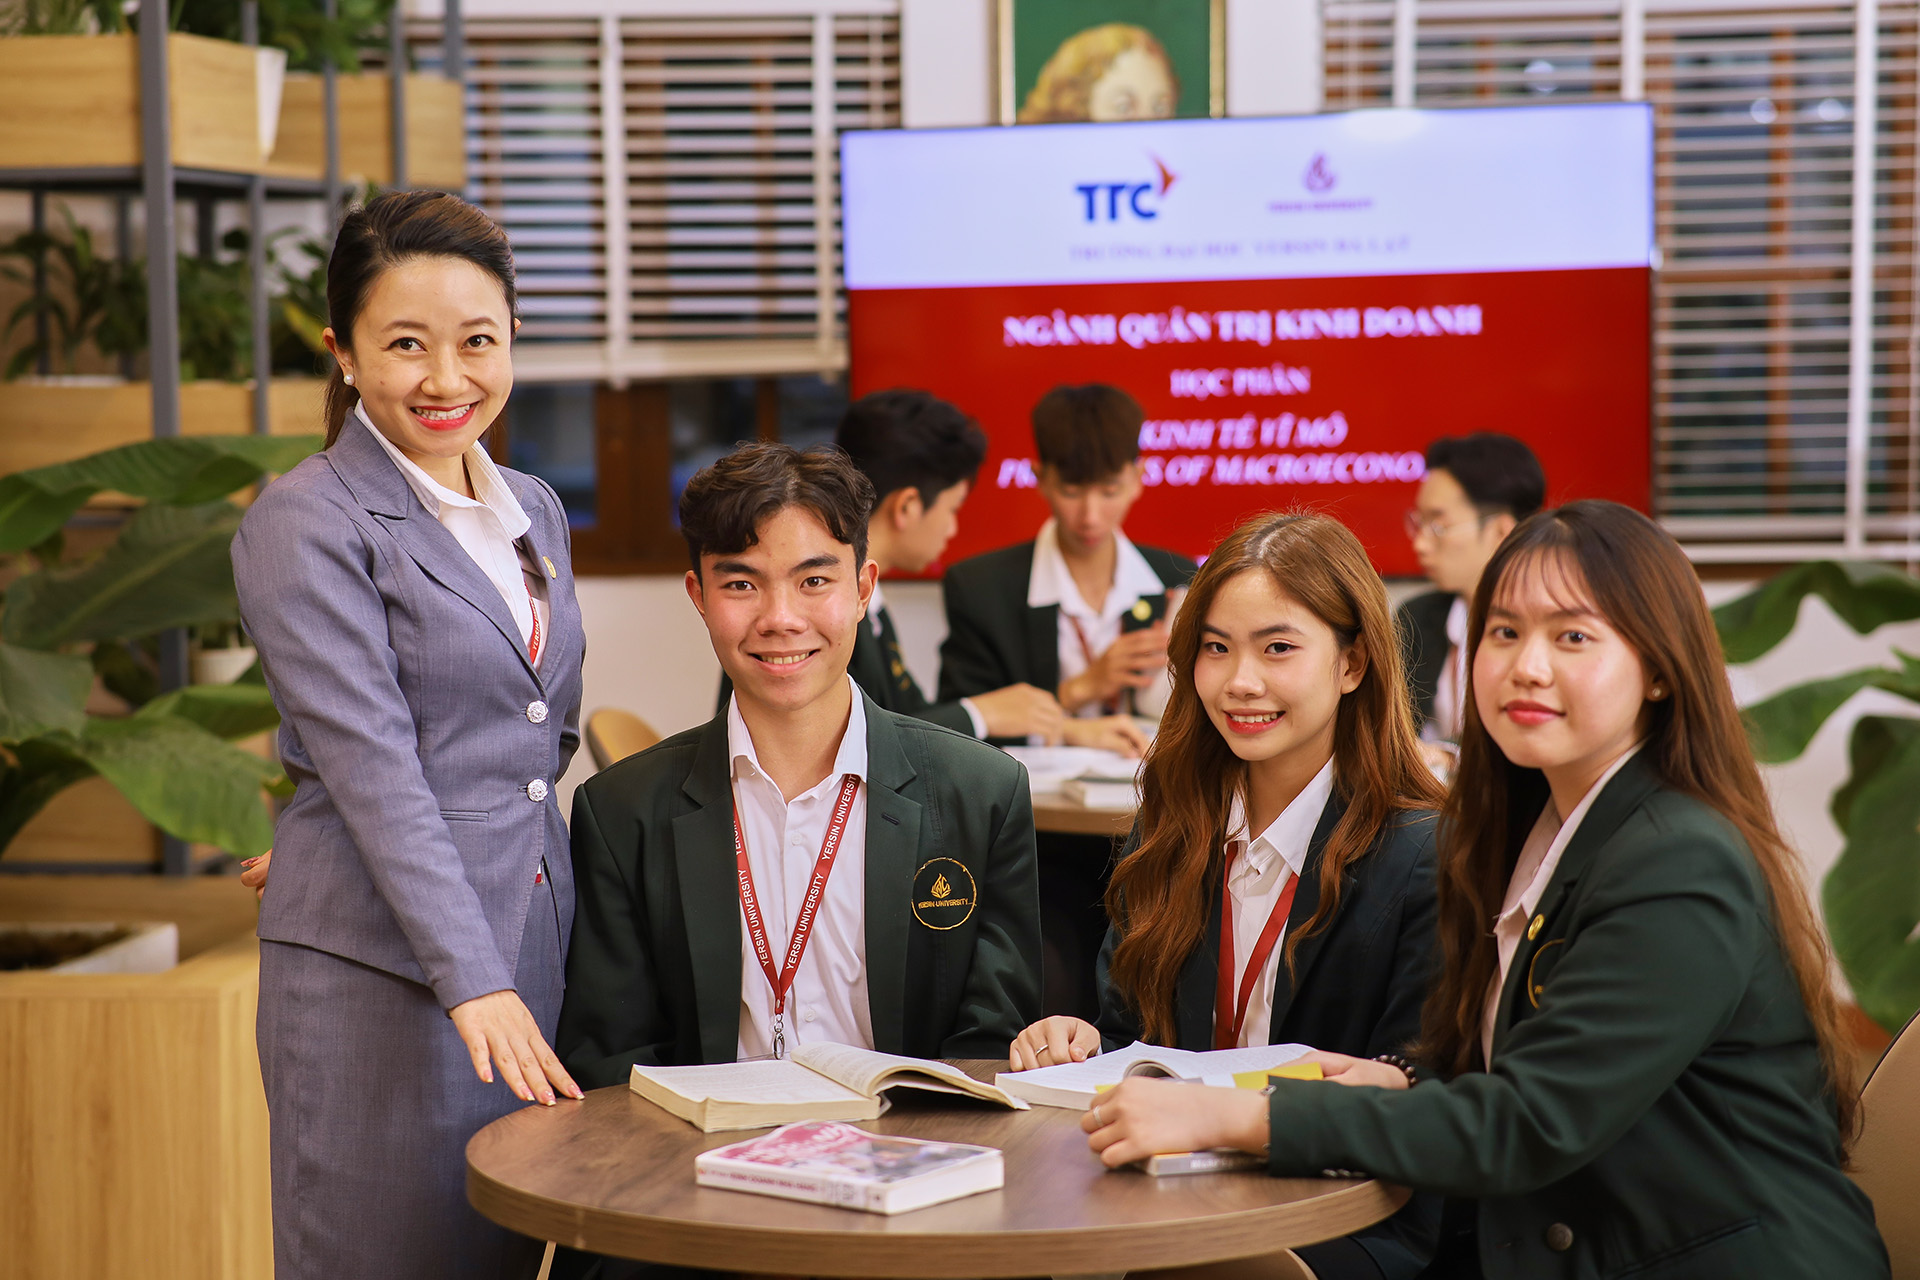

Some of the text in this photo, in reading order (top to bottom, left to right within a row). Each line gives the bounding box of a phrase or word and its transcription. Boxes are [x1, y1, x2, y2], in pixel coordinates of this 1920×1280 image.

[1075, 184, 1156, 220] TTC
[1003, 308, 1117, 347] NGÀNH
[1213, 309, 1272, 347] TRỊ
[1275, 307, 1360, 341] KINH
[1363, 304, 1483, 338] DOANH
[1170, 367, 1231, 402] HỌC
[1138, 418, 1215, 450] KINH
[1165, 454, 1214, 487] OF
[1211, 451, 1426, 486] MACROECONO
[821, 774, 857, 860] YERSIN UNIVERSIT
[738, 869, 770, 967] YERSIN UNIVERSITY
[785, 872, 824, 970] YERSIN UNIVERSITY
